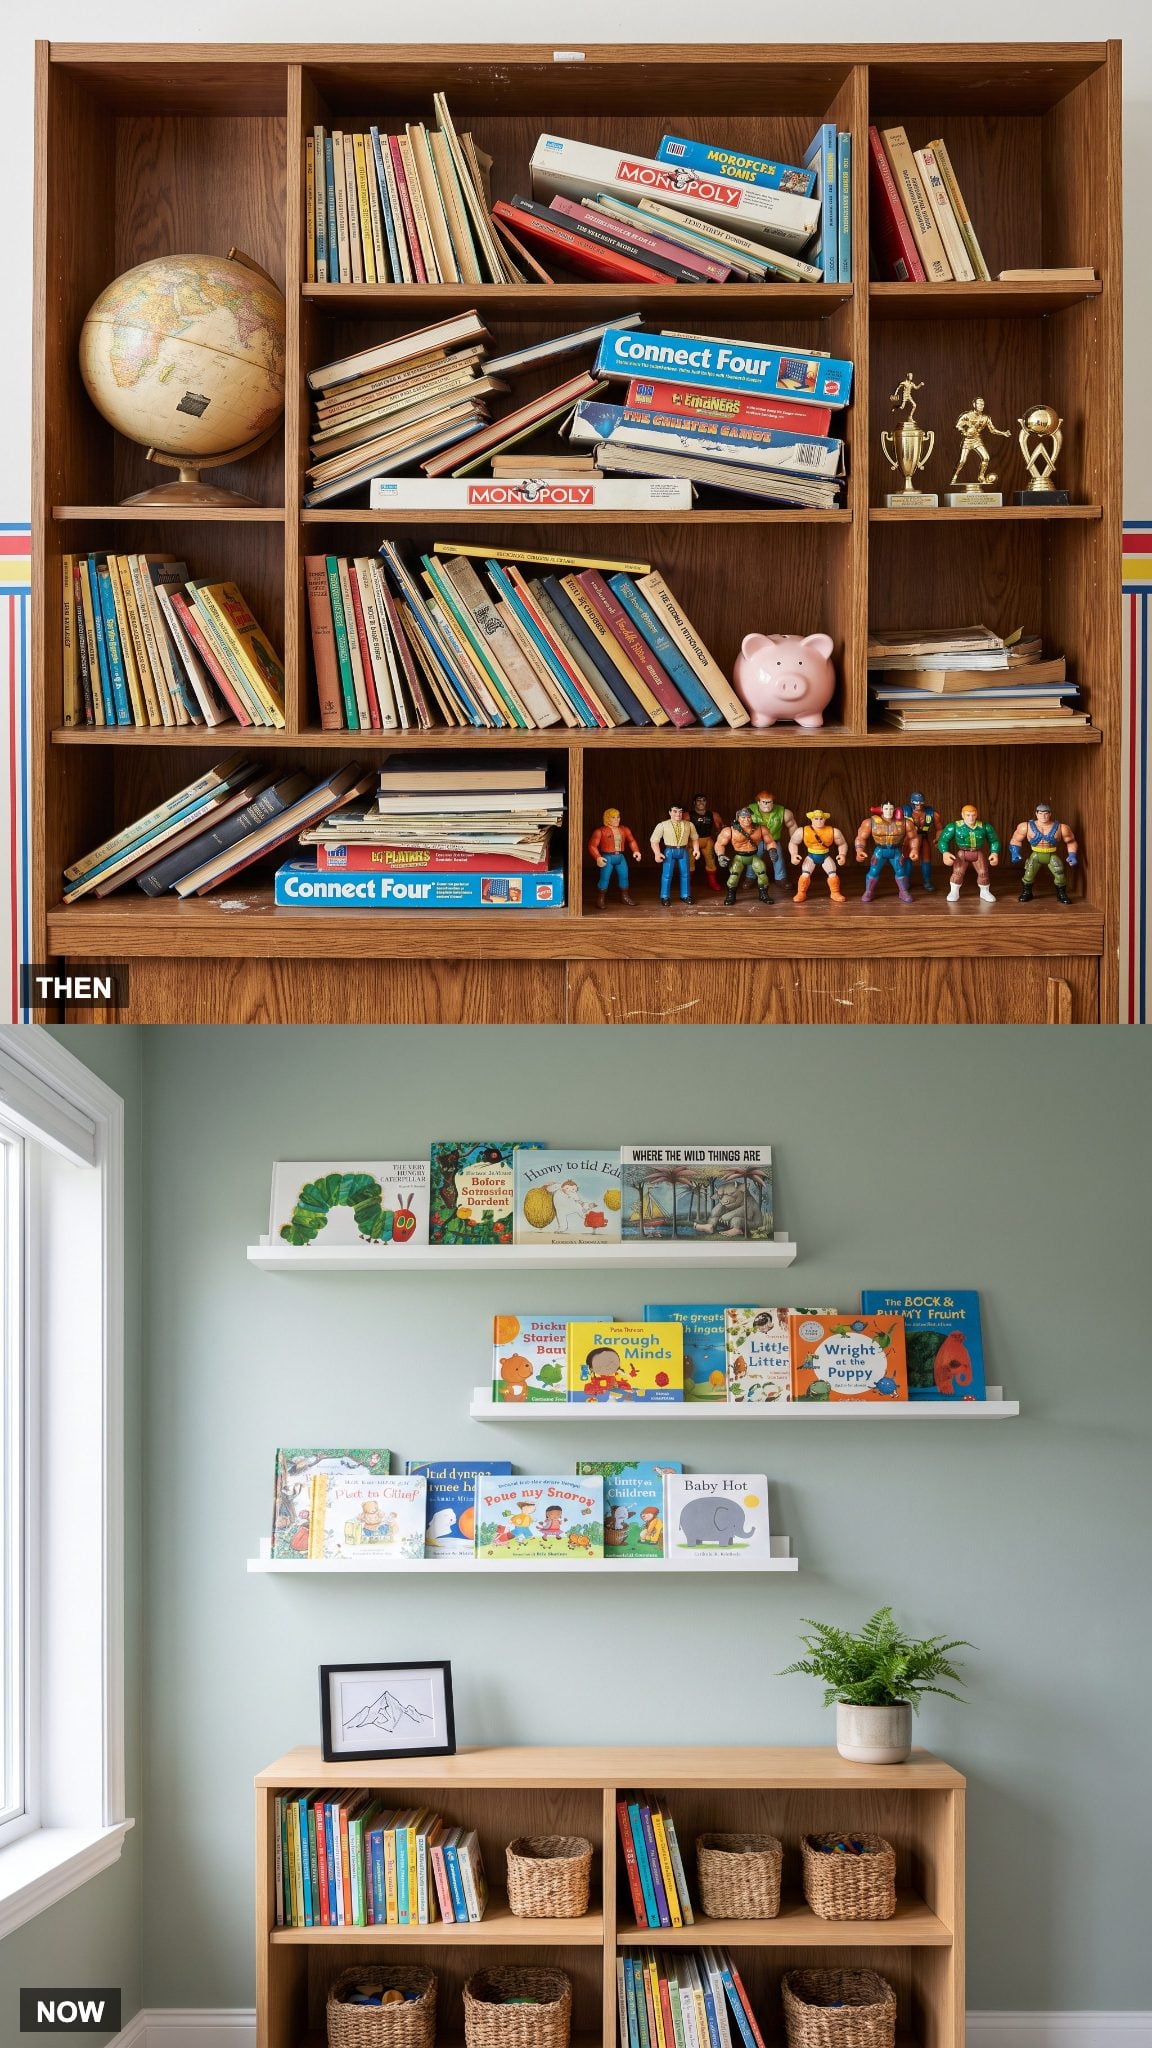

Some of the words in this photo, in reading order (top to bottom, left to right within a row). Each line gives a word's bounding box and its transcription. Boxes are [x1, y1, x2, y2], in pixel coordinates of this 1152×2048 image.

[619, 165, 739, 204] MONOPOLY
[614, 336, 712, 369] Connect
[716, 349, 771, 376] Four
[623, 410, 650, 423] THE
[471, 487, 591, 504] MONOPOLY
[284, 876, 375, 898] Connect
[381, 877, 432, 899] Four
[632, 1150, 662, 1161] WHERE
[665, 1150, 681, 1161] THE
[684, 1150, 705, 1161] WILD
[708, 1150, 740, 1161] THINGS
[744, 1150, 761, 1161] ARE
[567, 1162, 578, 1170] to
[885, 1298, 902, 1306] The
[943, 1297, 954, 1307] &
[593, 1334, 660, 1349] Rarough
[751, 1341, 789, 1354] Little
[624, 1348, 672, 1359] Minds
[824, 1344, 876, 1359] Wright
[749, 1357, 789, 1367] Litter
[828, 1367, 873, 1381] Puppy
[608, 1488, 656, 1498] Children
[685, 1480, 719, 1493] Baby
[722, 1480, 748, 1491] Hot
